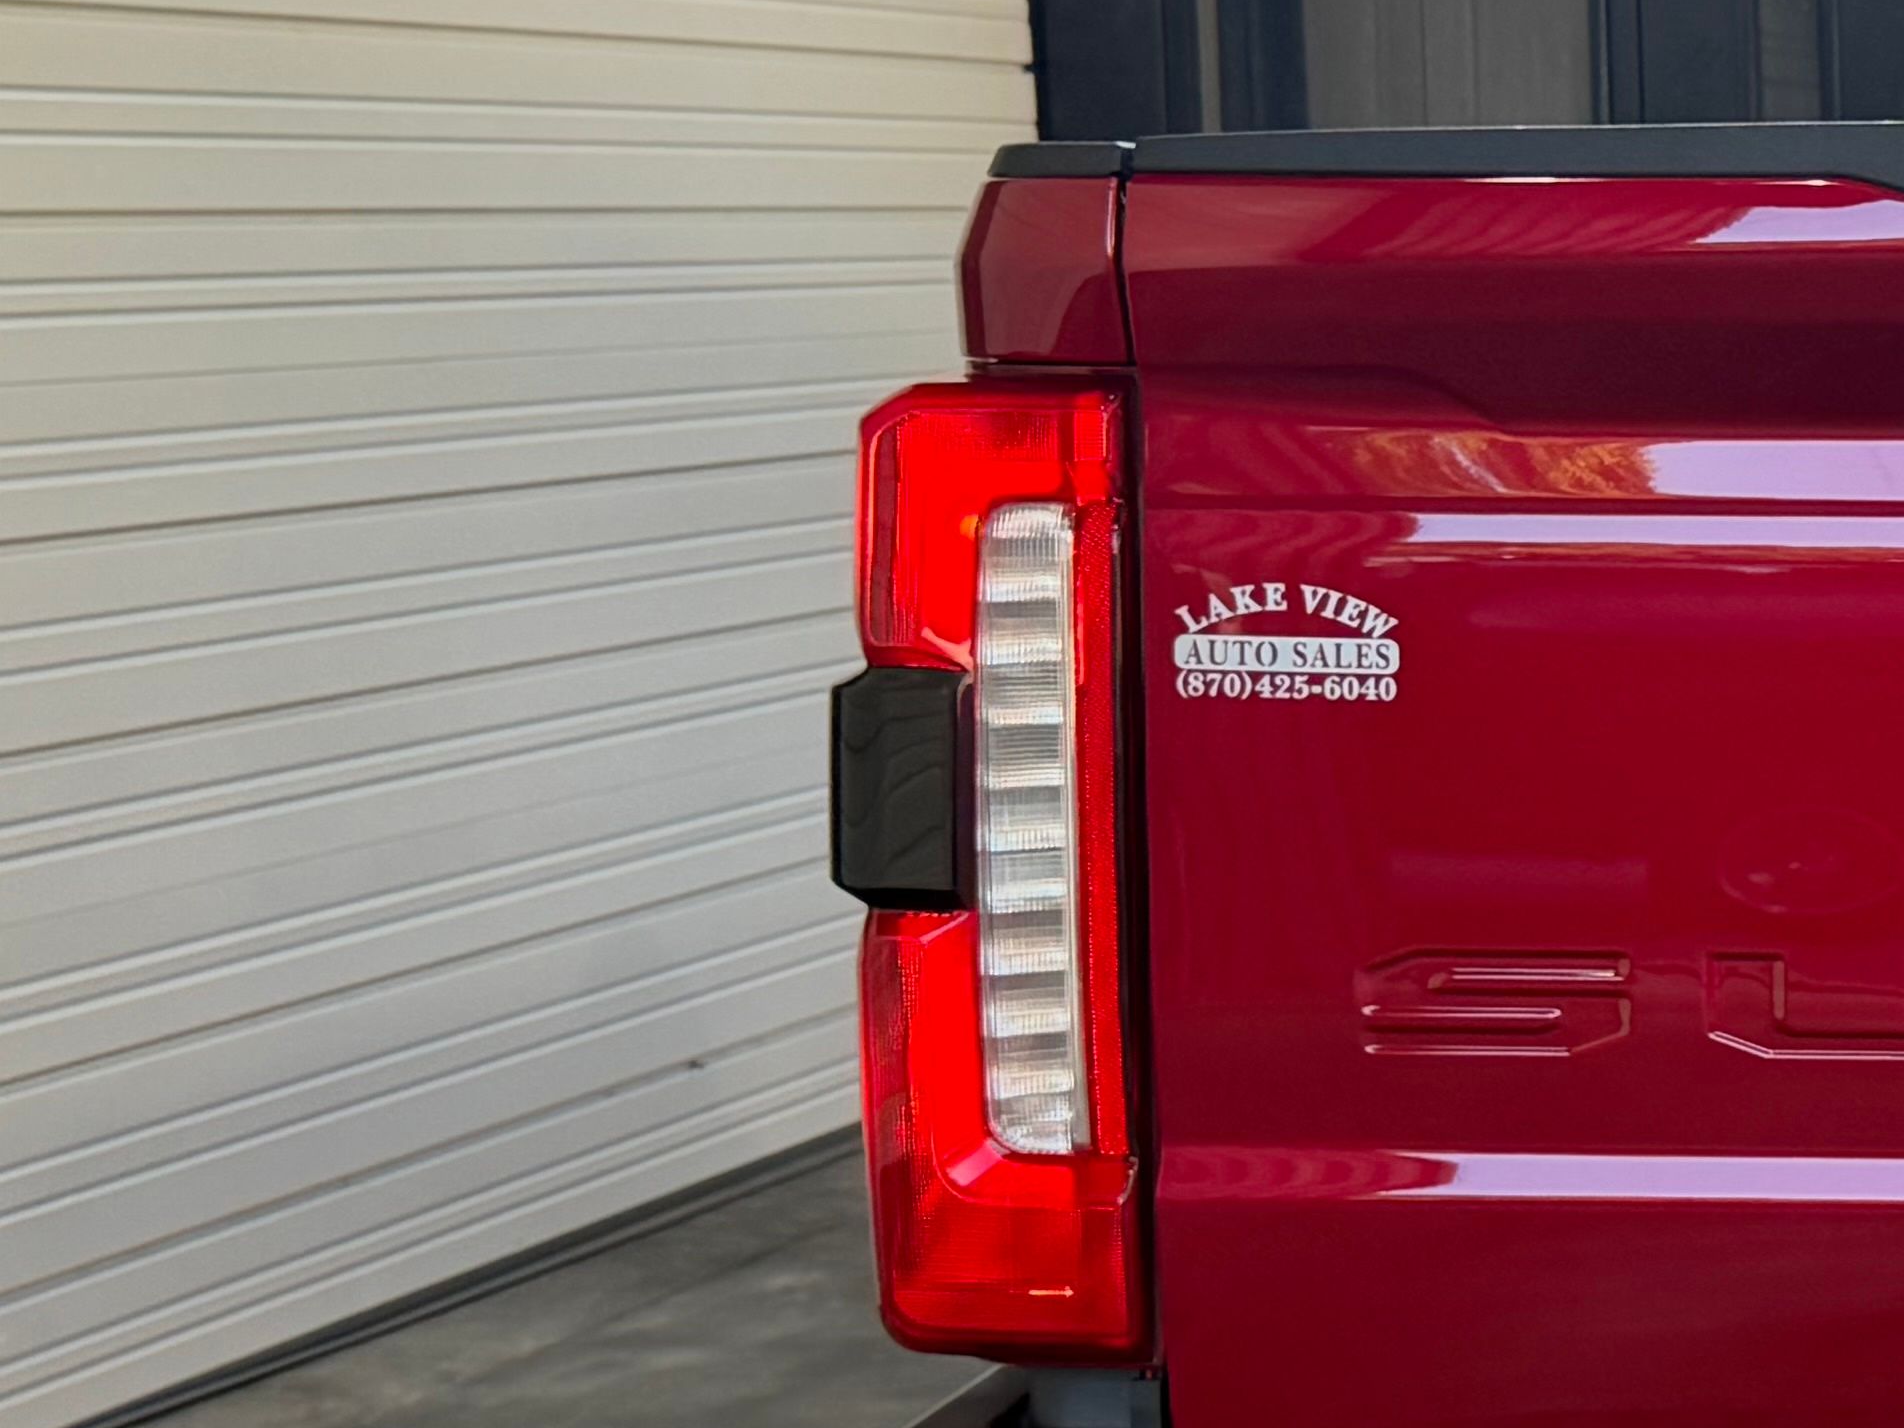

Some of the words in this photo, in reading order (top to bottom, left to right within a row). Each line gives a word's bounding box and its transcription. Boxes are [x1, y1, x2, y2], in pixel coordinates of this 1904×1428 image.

[1174, 582, 1288, 634] LAKE
[1300, 583, 1399, 638] VIEW
[1184, 639, 1278, 667] AUTO
[1292, 642, 1391, 670] SALES
[1176, 671, 1397, 702] (870)425-6040
